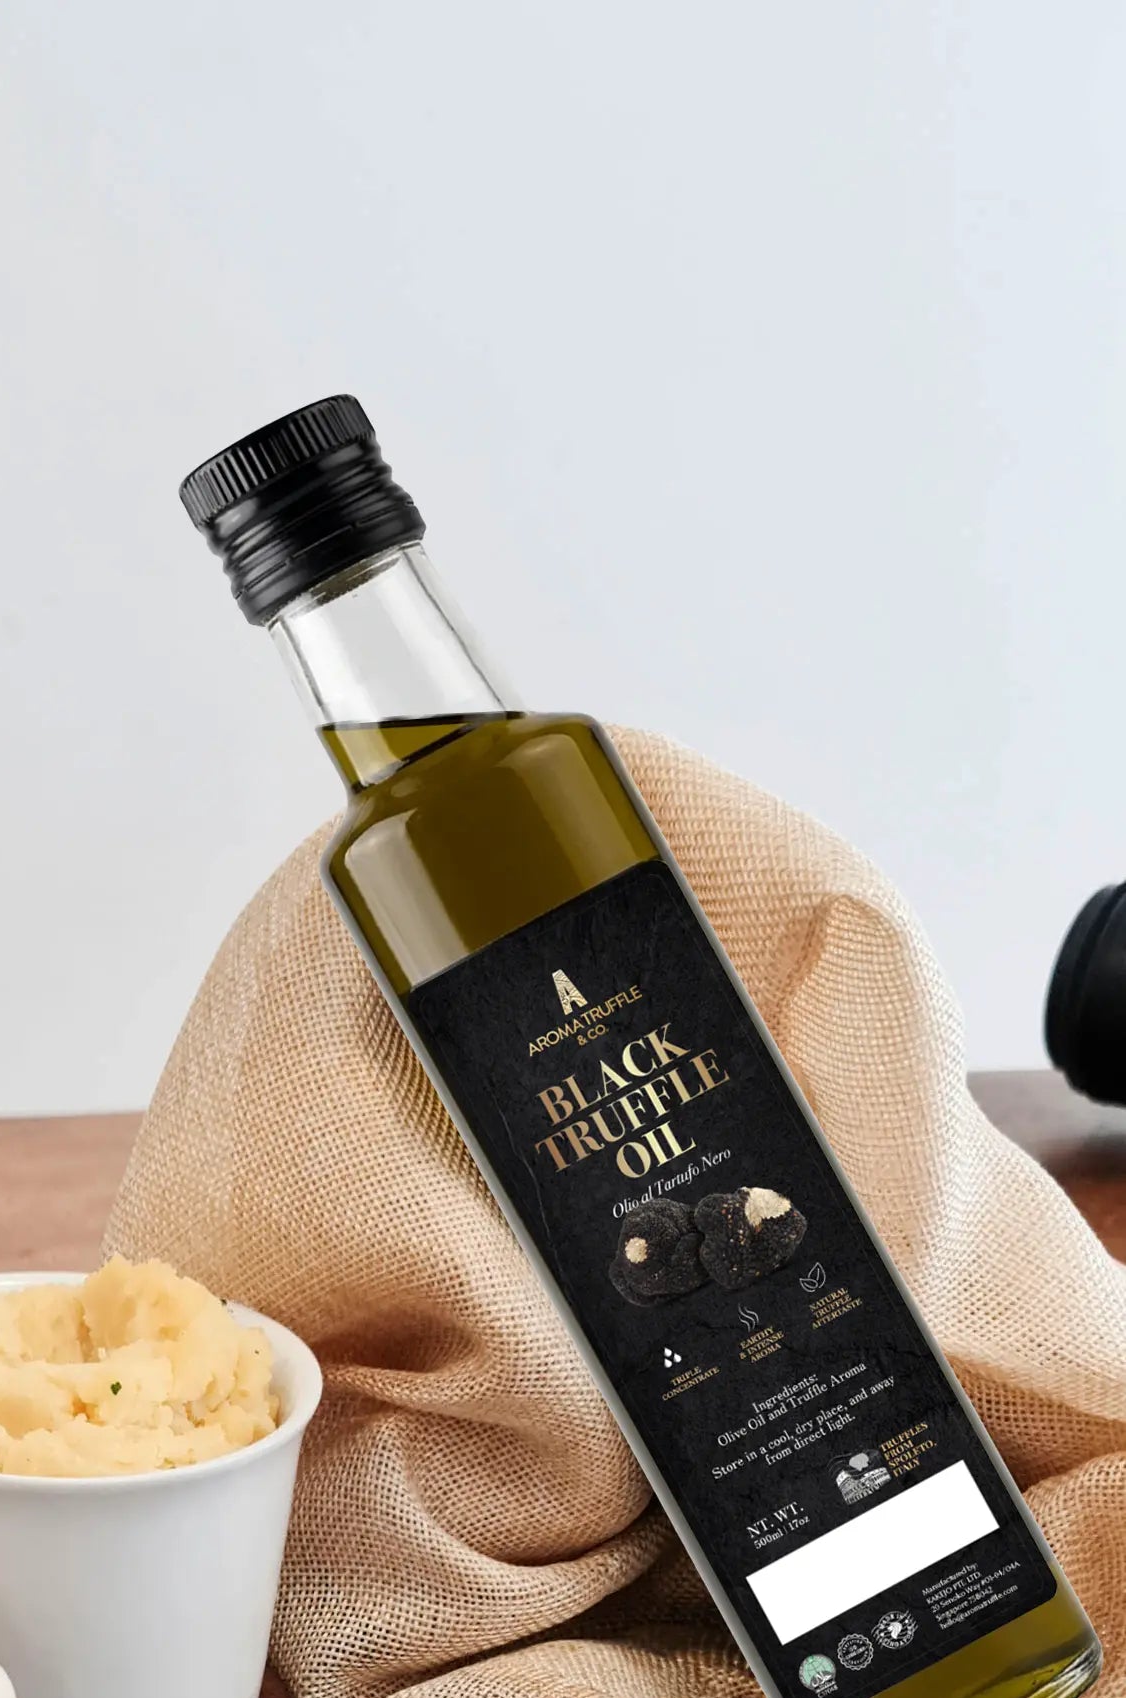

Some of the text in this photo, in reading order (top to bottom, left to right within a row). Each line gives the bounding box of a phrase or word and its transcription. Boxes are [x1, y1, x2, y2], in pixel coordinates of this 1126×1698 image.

[579, 984, 643, 1026] TRUFFLE
[575, 1023, 609, 1046] & CO.
[537, 1021, 689, 1125] BLACK
[534, 1048, 730, 1171] TRUFFLE
[615, 1119, 697, 1179] OIL
[611, 1148, 731, 1219] Olio al Tartufo Nero
[808, 1286, 848, 1312] NATURAL
[811, 1297, 863, 1328] AFTERTASTE
[812, 1293, 852, 1319] TRUFFLE
[738, 1330, 784, 1360] & INTENSE
[739, 1325, 774, 1349] EARTHY
[750, 1341, 782, 1363] AROMA
[661, 1366, 720, 1401] CONCENTRATE
[670, 1365, 702, 1386] TRIPLE
[716, 1362, 867, 1447] Olive Oil and Truffle Aroma
[750, 1373, 819, 1414] Ingredients:
[710, 1374, 894, 1480] Store in a cool, dry place, and away
[764, 1412, 856, 1466] from direct light.
[879, 1422, 928, 1452] TRUFFLES
[883, 1438, 914, 1461] FROM
[891, 1457, 920, 1477] ITALY
[745, 1500, 804, 1539] NT. WT.
[752, 1527, 784, 1550] 500ml
[787, 1514, 810, 1531] 17oz
[920, 1565, 968, 1596] Manufactured
[929, 1602, 941, 1614] 20
[938, 1590, 967, 1608] Senoko
[963, 1582, 981, 1594] Way
[934, 1599, 968, 1622] Singapore
